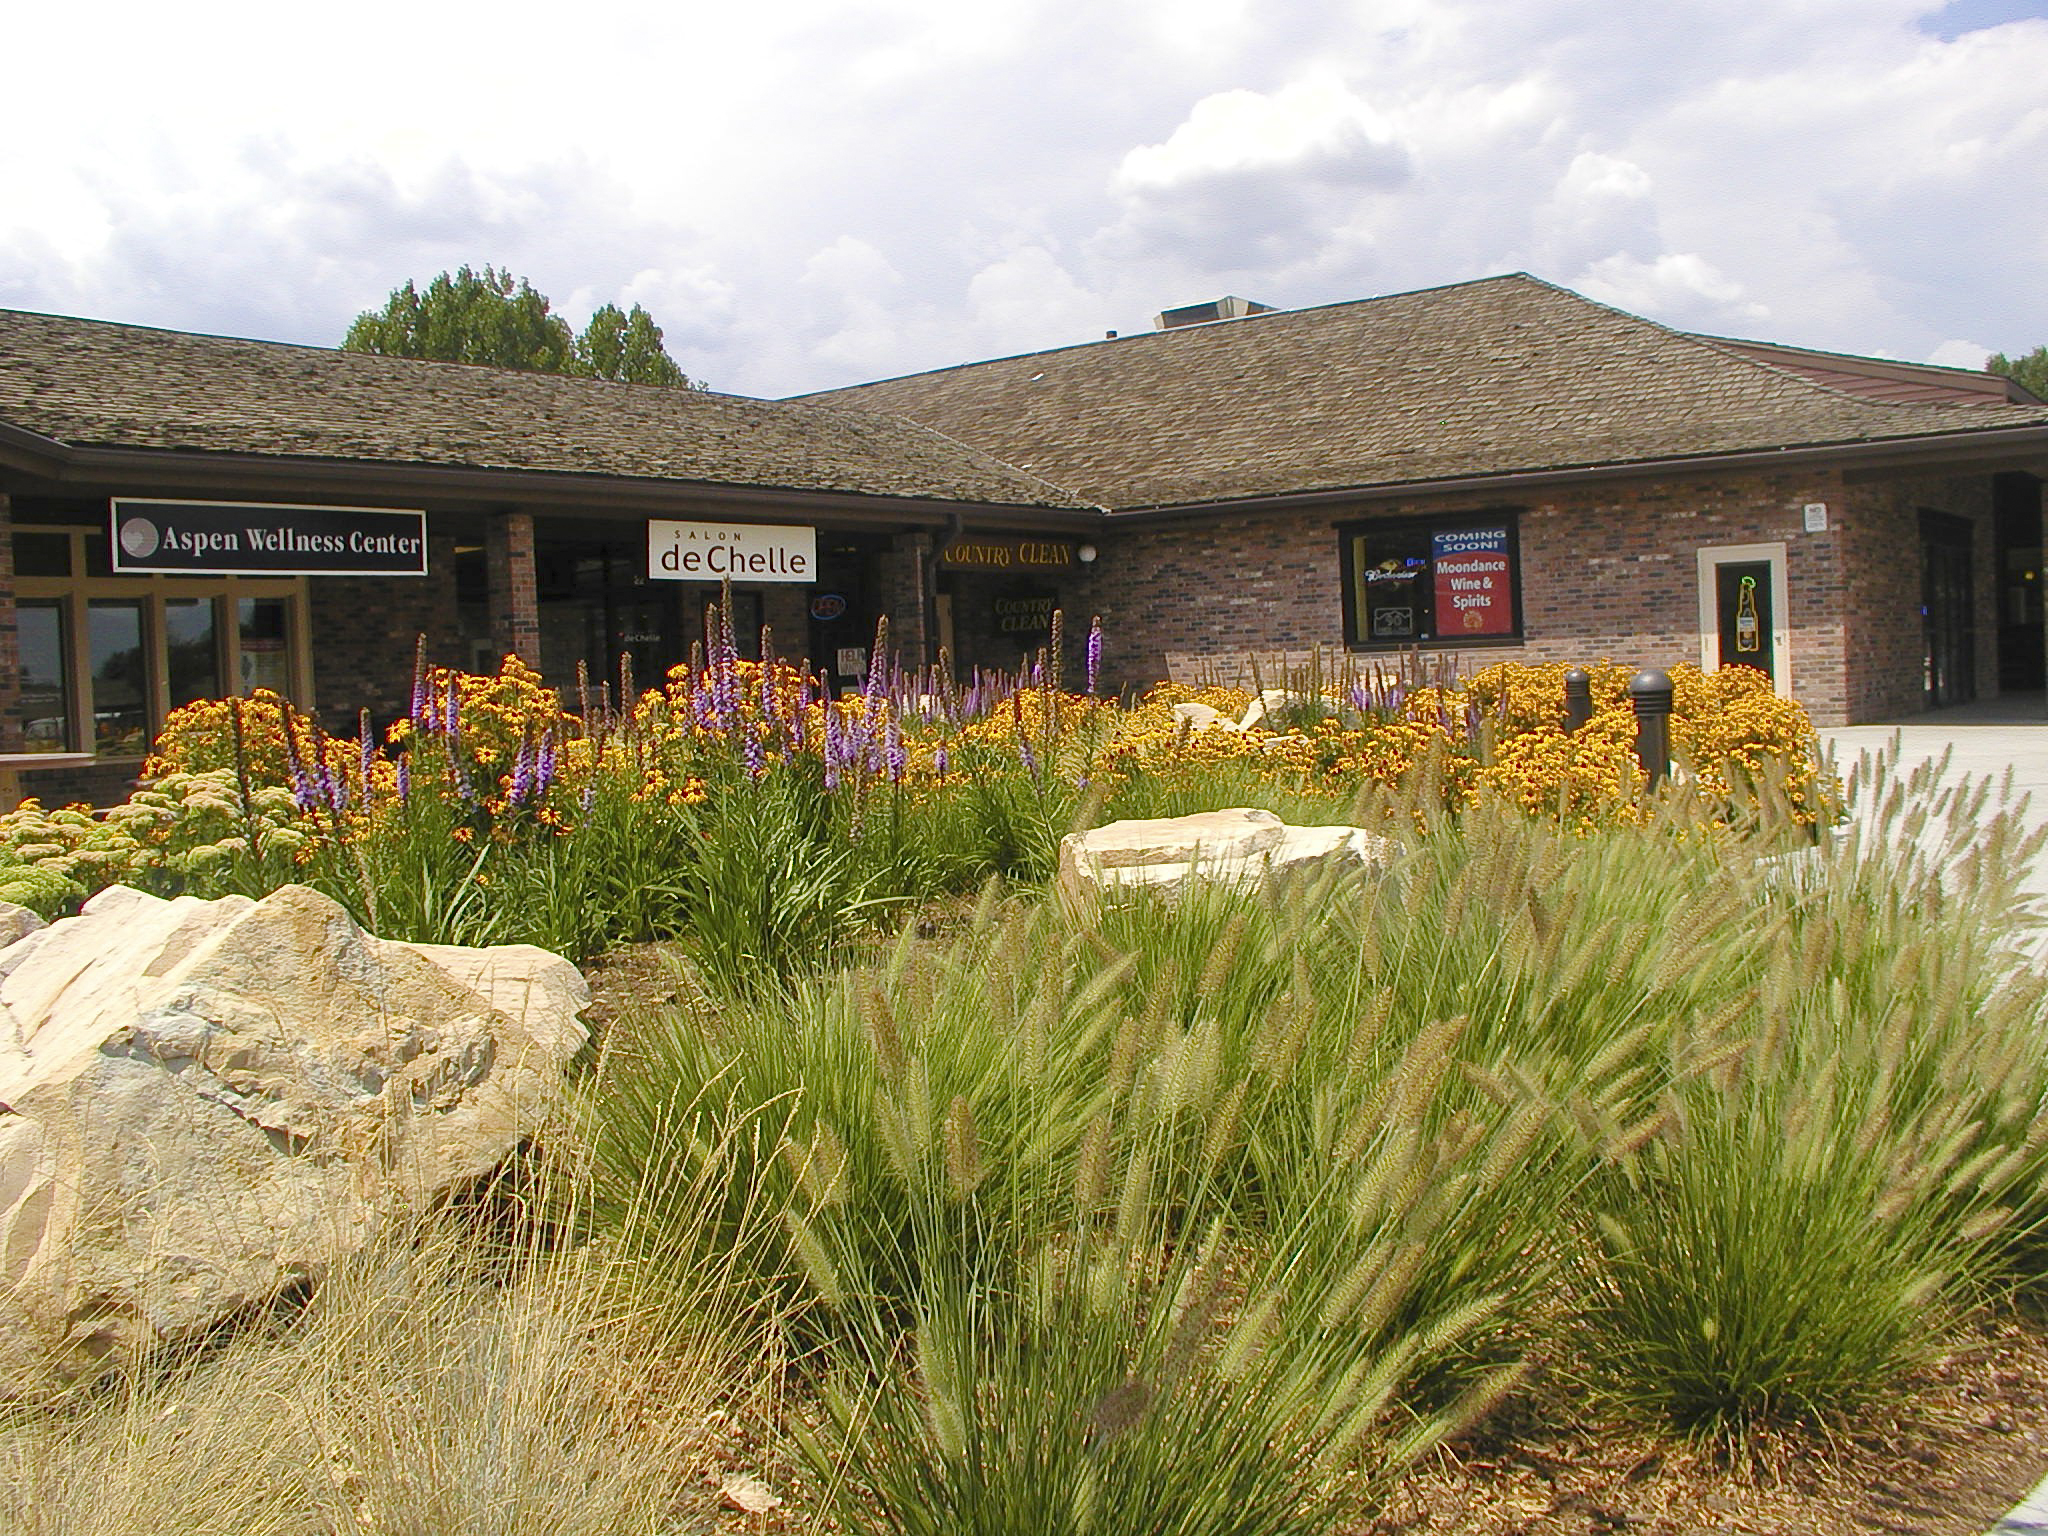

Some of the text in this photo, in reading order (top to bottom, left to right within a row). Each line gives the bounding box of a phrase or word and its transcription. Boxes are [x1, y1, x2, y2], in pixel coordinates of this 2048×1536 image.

[163, 526, 420, 557] Aspen Wellness Center
[674, 530, 742, 541] SALON
[1434, 530, 1506, 543] COMING
[1019, 542, 1071, 565] CLEAN
[1443, 541, 1498, 552] SOON!
[1437, 558, 1505, 575] Moondance
[1450, 577, 1492, 591] Wine &
[995, 598, 1053, 614] COUNTRY
[1453, 593, 1491, 611] Spirits
[1003, 614, 1049, 631] CLEAN
